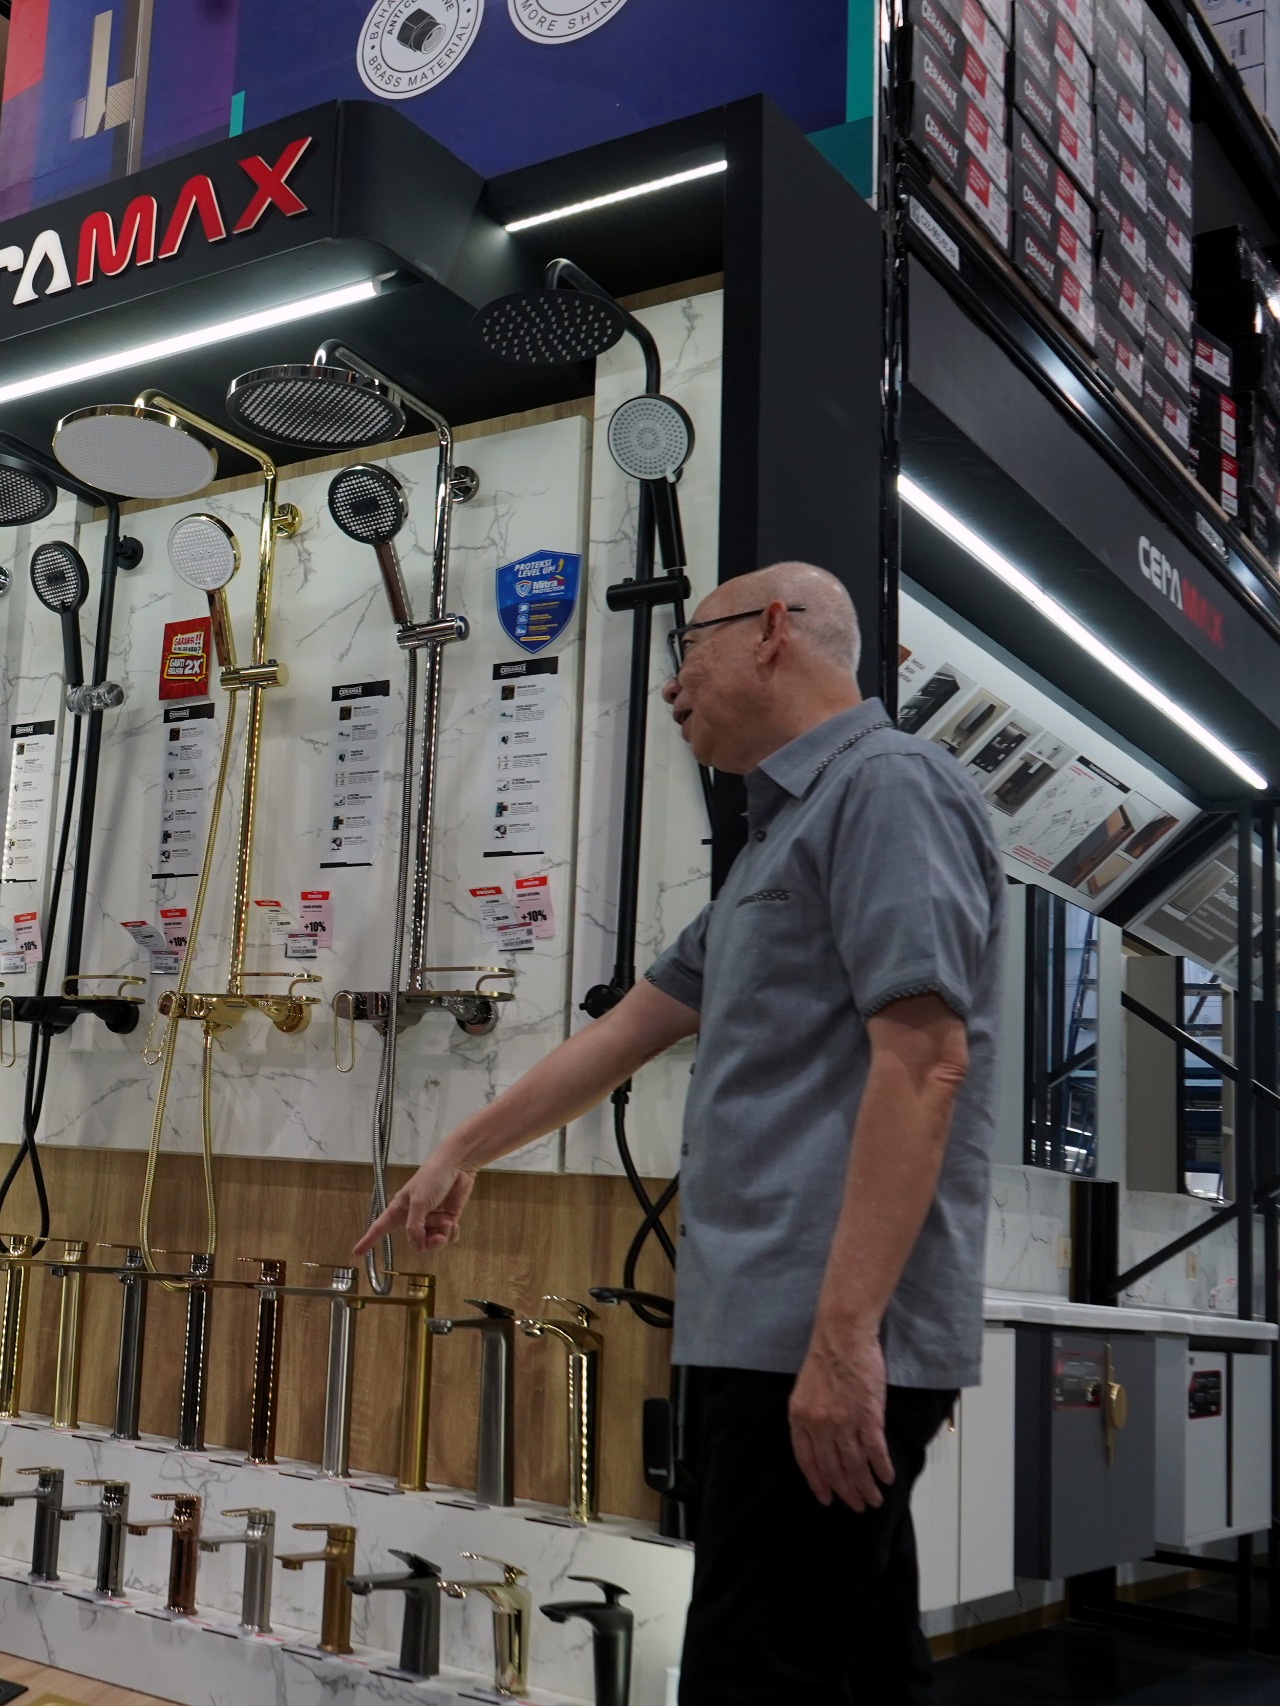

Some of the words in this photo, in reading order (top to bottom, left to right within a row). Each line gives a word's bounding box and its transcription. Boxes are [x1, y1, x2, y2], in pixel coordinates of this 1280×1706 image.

[387, 9, 404, 35] ANTI
[521, 0, 558, 31] MORE
[368, 55, 402, 88] BRASS
[407, 22, 471, 87] MATERIAL
[514, 559, 552, 572] PROTEKSI
[518, 568, 541, 578] LEVEL
[542, 565, 556, 575] UP!
[532, 580, 558, 590] Mitra
[184, 658, 202, 674] 2X
[521, 909, 547, 922] +10%
[304, 921, 326, 933] +10%
[20, 940, 37, 951] +10%
